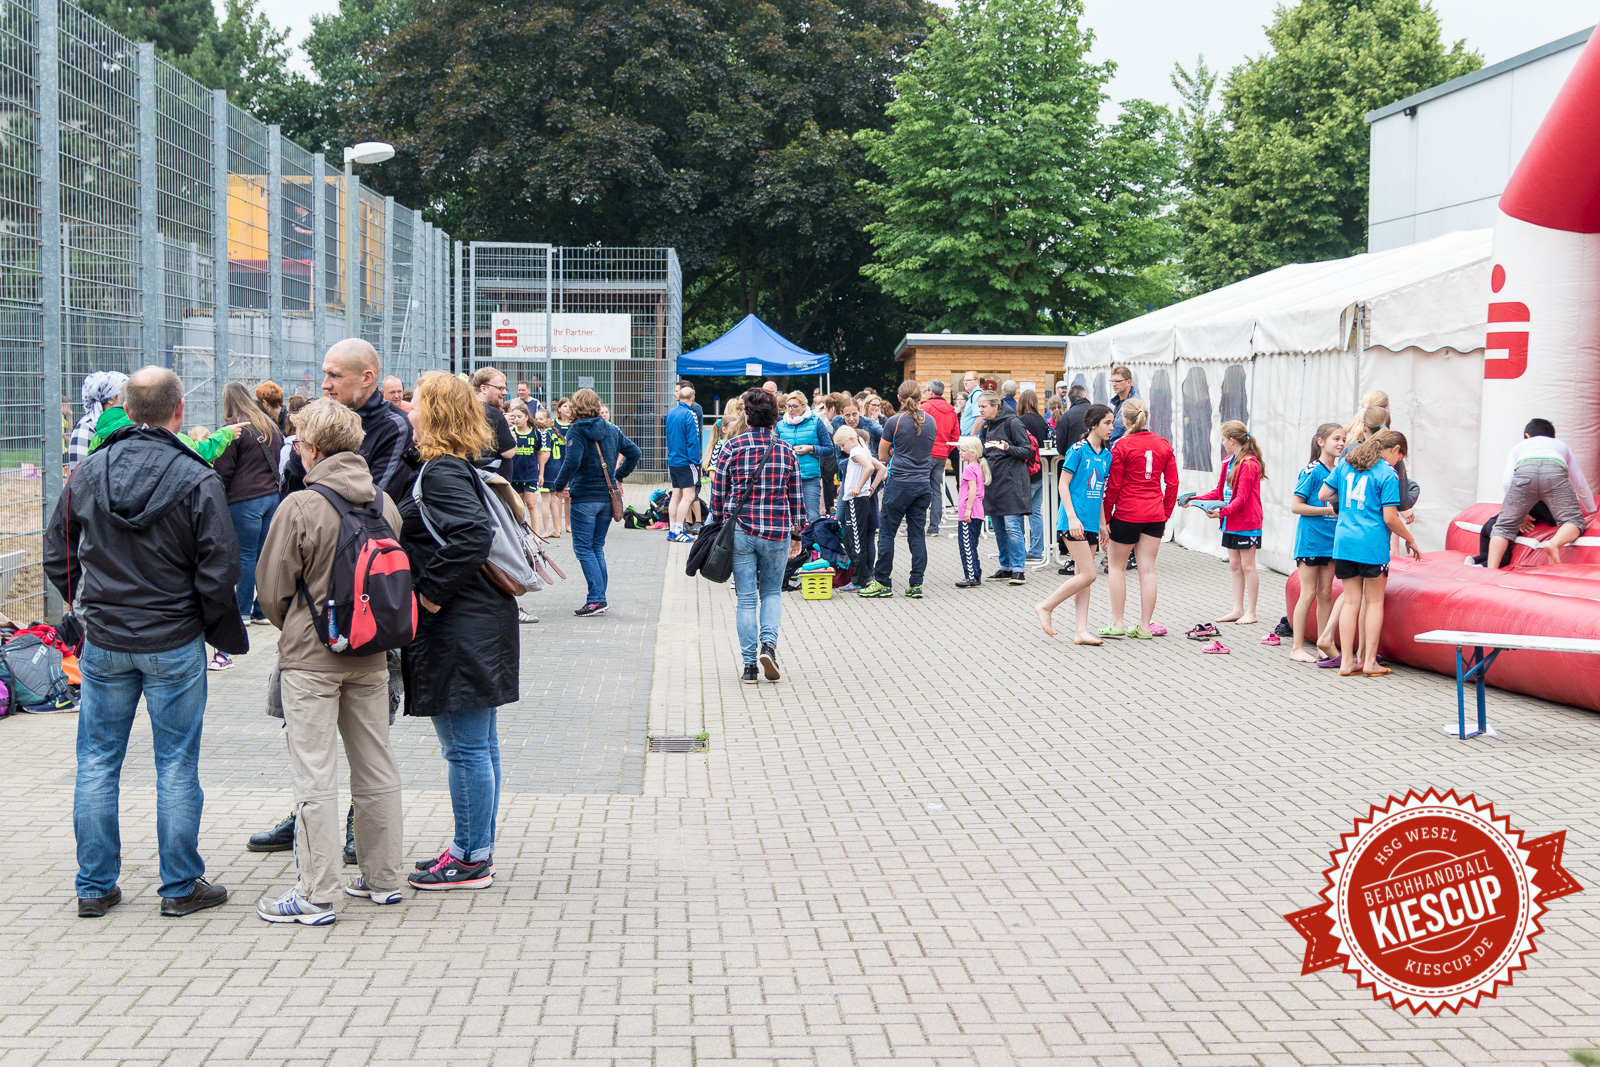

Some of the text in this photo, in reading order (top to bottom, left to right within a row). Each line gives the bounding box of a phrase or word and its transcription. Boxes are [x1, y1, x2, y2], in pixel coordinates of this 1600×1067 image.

[554, 328, 563, 336] Ihr
[605, 345, 627, 353] Wesel
[1086, 459, 1090, 469] 7
[1145, 450, 1153, 479] 1
[1346, 472, 1368, 510] 14
